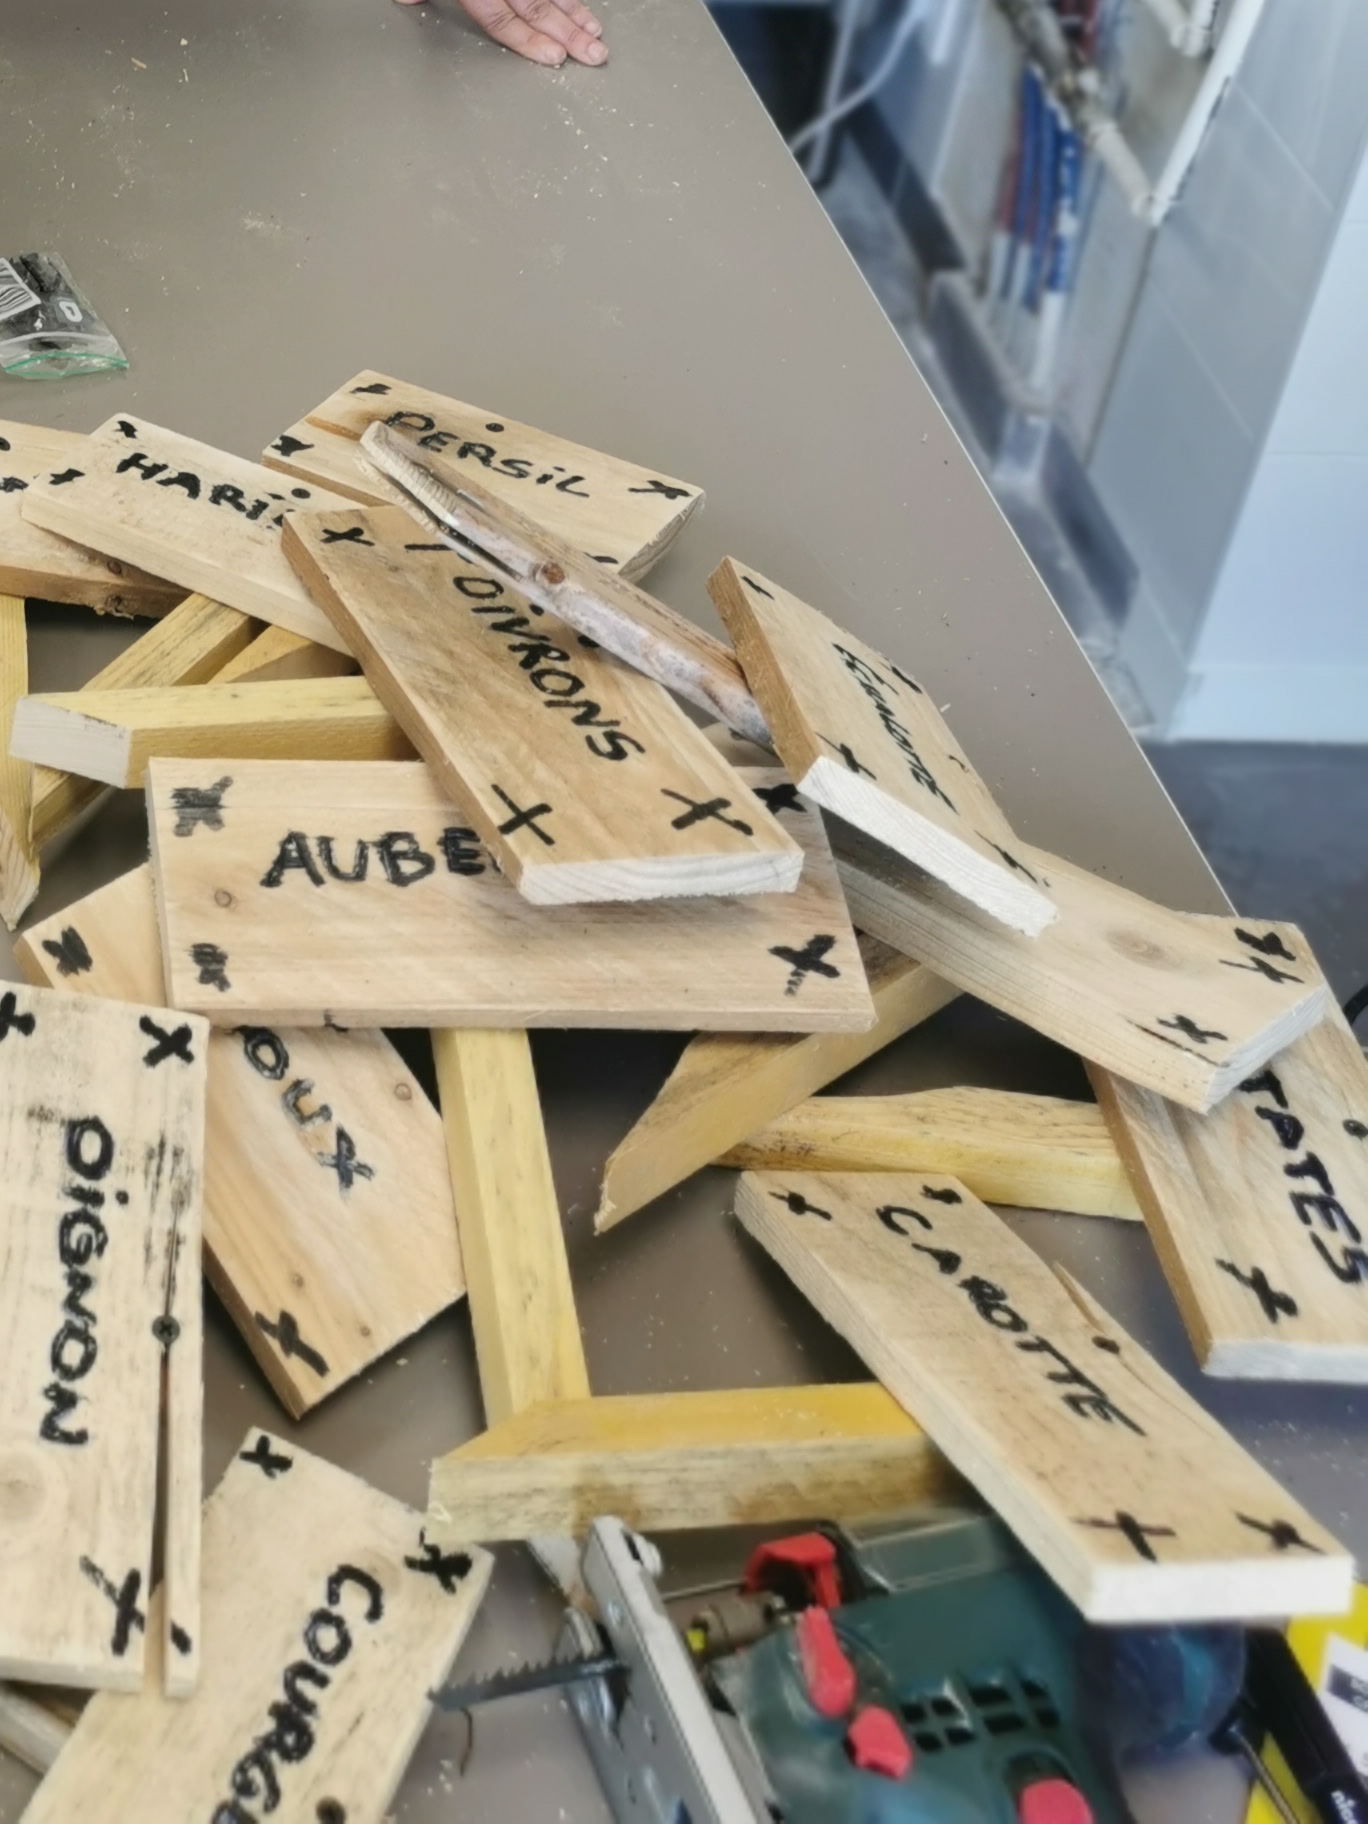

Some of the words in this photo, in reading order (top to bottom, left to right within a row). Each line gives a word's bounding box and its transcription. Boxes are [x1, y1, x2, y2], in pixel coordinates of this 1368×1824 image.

[259, 826, 502, 888] AUBE
[226, 1024, 375, 1196] OUX
[1237, 1069, 1368, 1283] TATES
